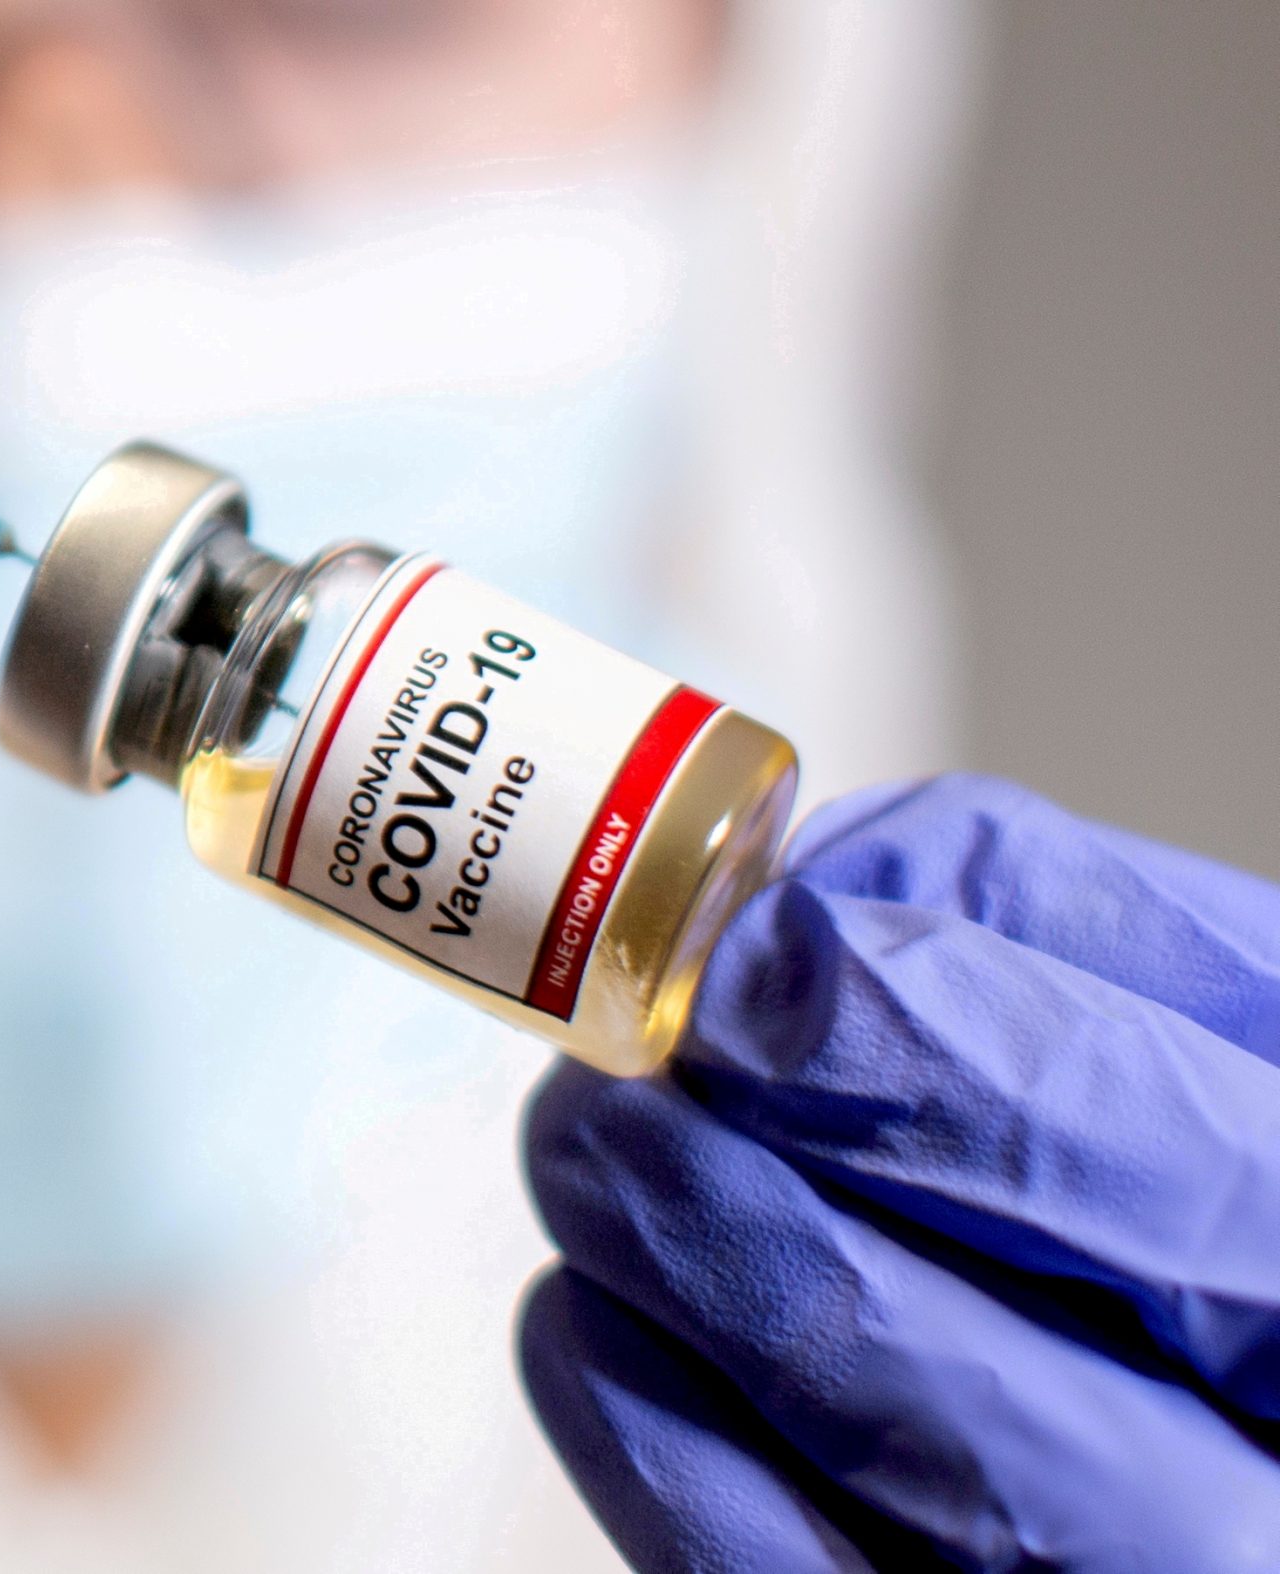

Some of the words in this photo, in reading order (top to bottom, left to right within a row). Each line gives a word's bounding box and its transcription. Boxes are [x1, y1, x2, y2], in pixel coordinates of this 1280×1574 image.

[328, 646, 449, 887] CORONAVIRUS
[366, 628, 537, 914] COVID-19
[430, 755, 536, 938] Vaccine
[546, 877, 603, 988] INJECTION
[588, 812, 632, 875] ONLY
